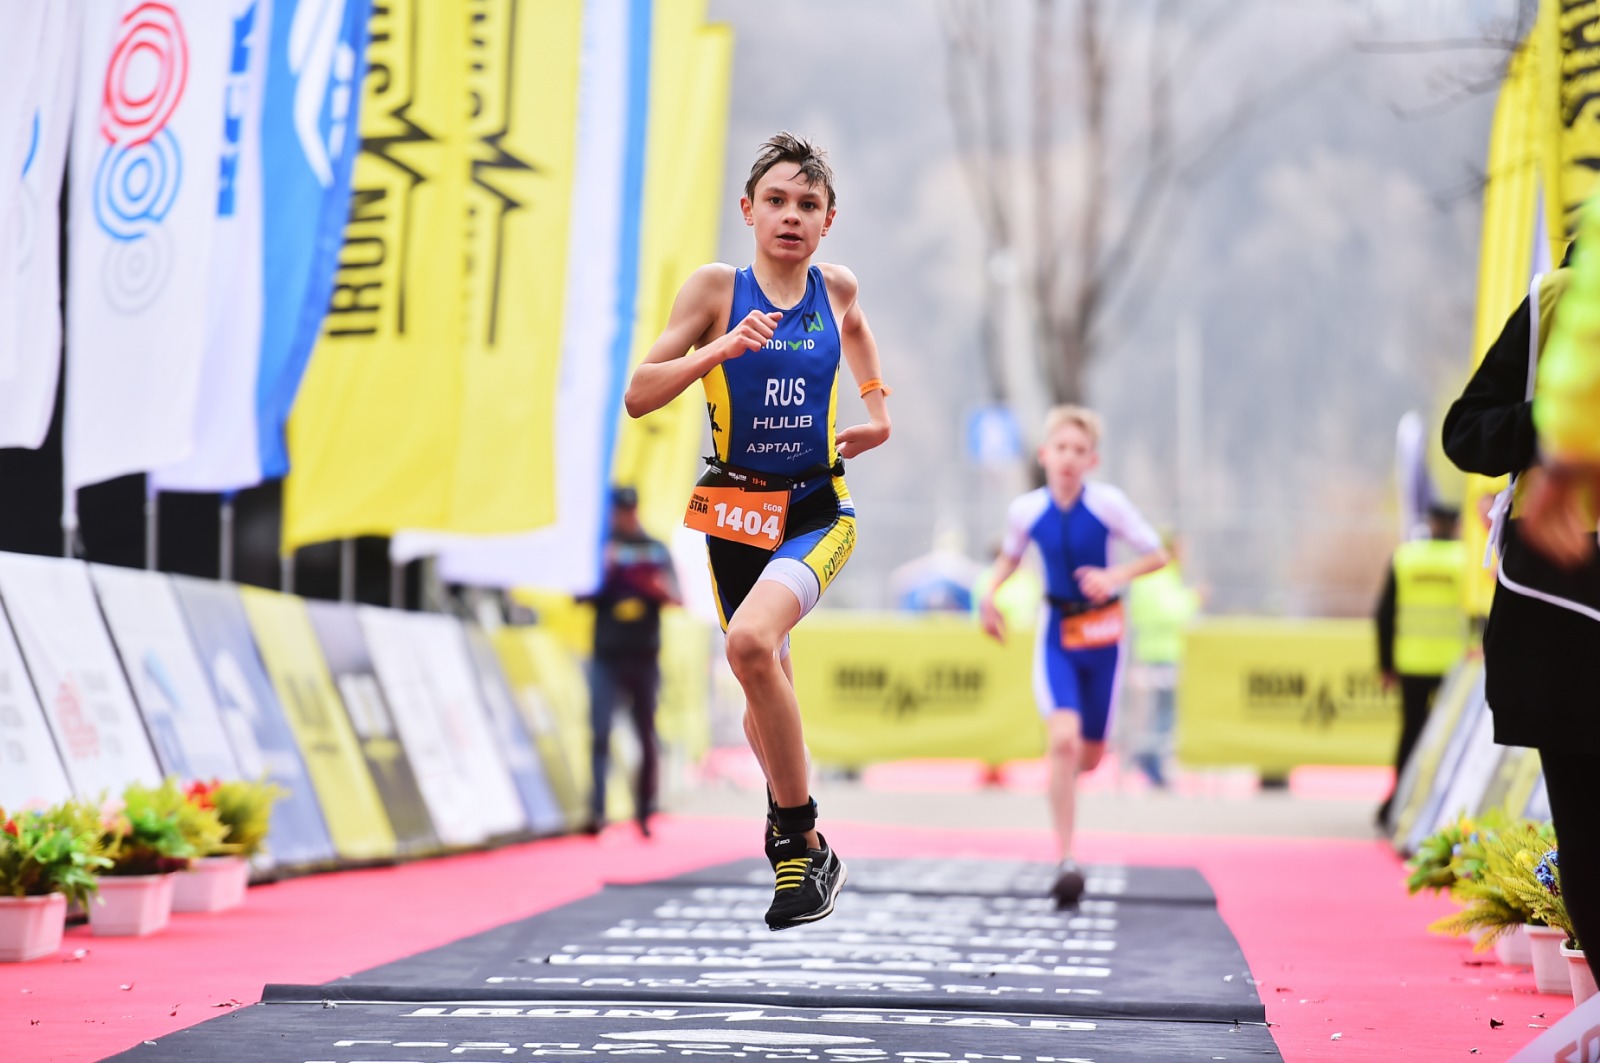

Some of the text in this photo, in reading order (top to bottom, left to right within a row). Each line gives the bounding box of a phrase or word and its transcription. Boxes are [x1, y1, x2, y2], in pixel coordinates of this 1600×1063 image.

[764, 377, 806, 406] RUS
[753, 415, 813, 430] HUUB
[752, 478, 767, 487] 13-14
[689, 501, 708, 515] STAR
[763, 502, 783, 514] EGOR
[714, 502, 780, 541] 1404
[410, 1007, 1097, 1031] IRON STAR
